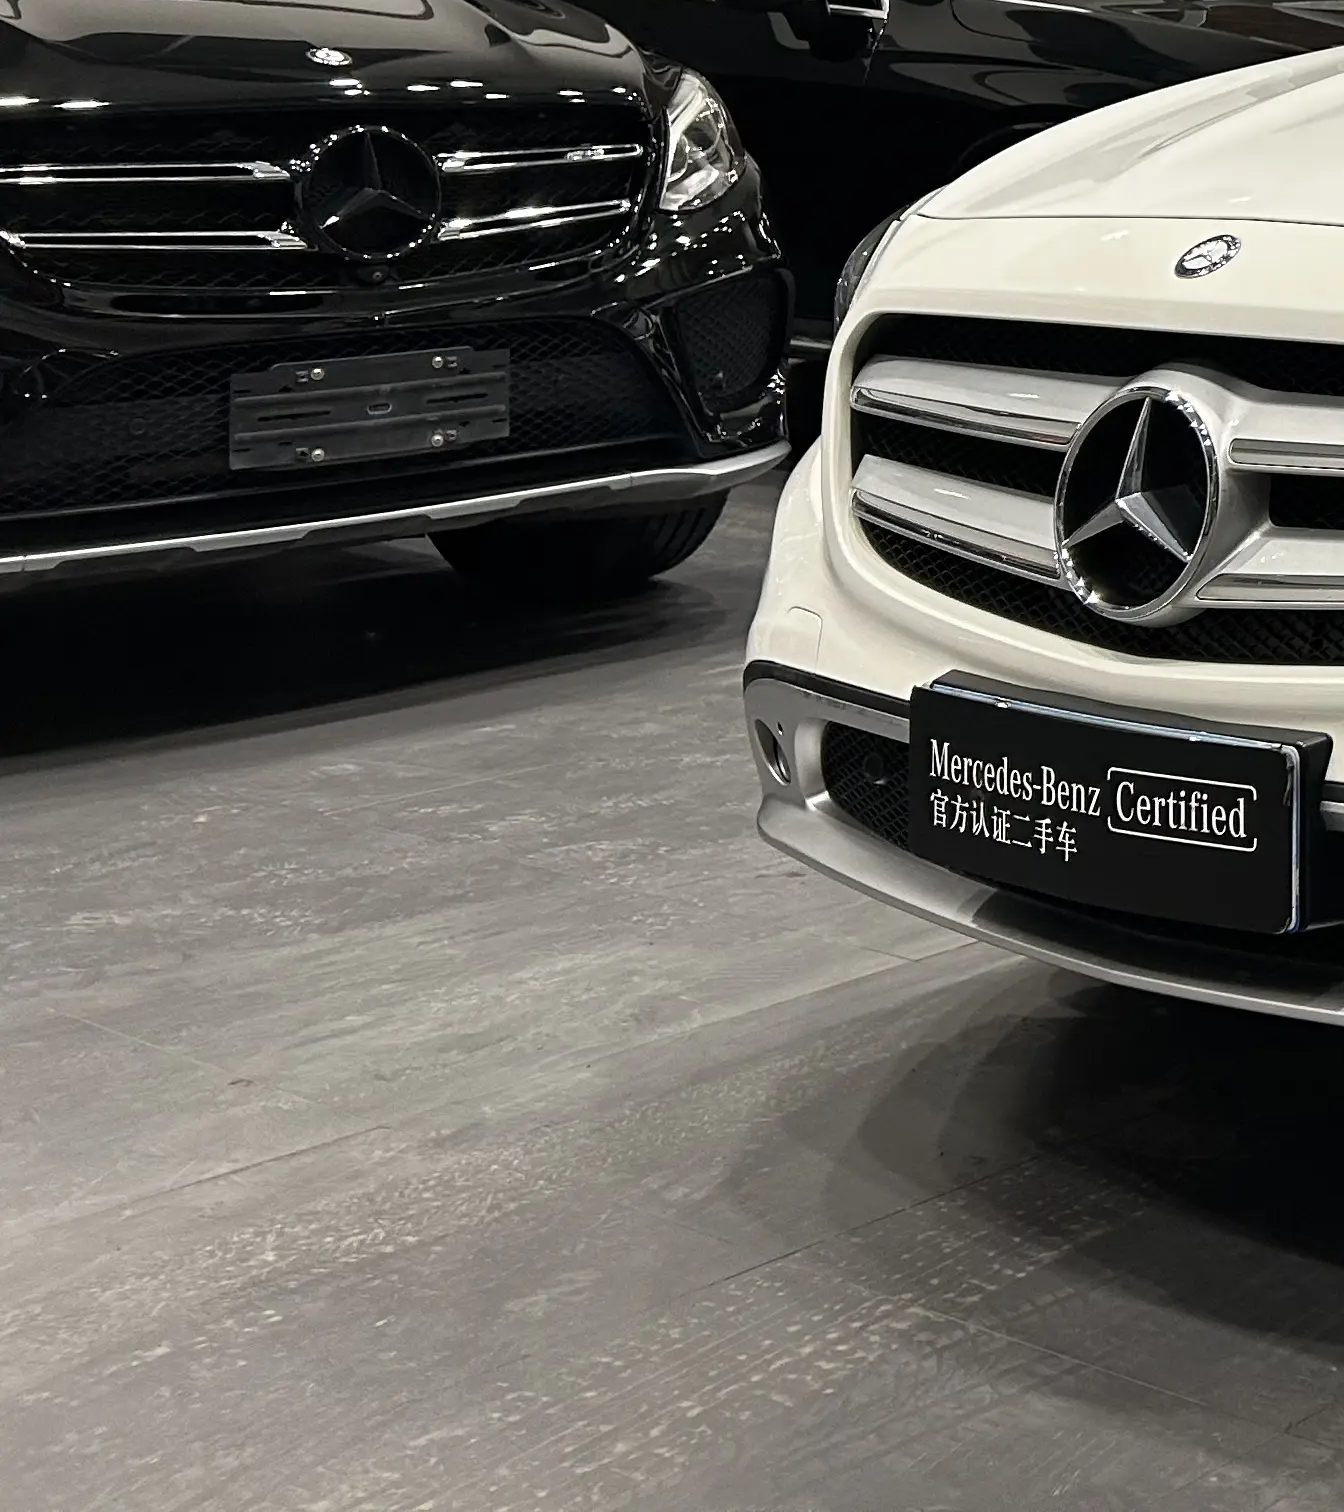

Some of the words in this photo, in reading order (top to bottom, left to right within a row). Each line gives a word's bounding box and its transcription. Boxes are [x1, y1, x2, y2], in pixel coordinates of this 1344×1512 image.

[930, 739, 1101, 817] Mercedes-Benz
[1116, 781, 1248, 838] Certified
[930, 789, 1078, 862] 官方认证二手车
